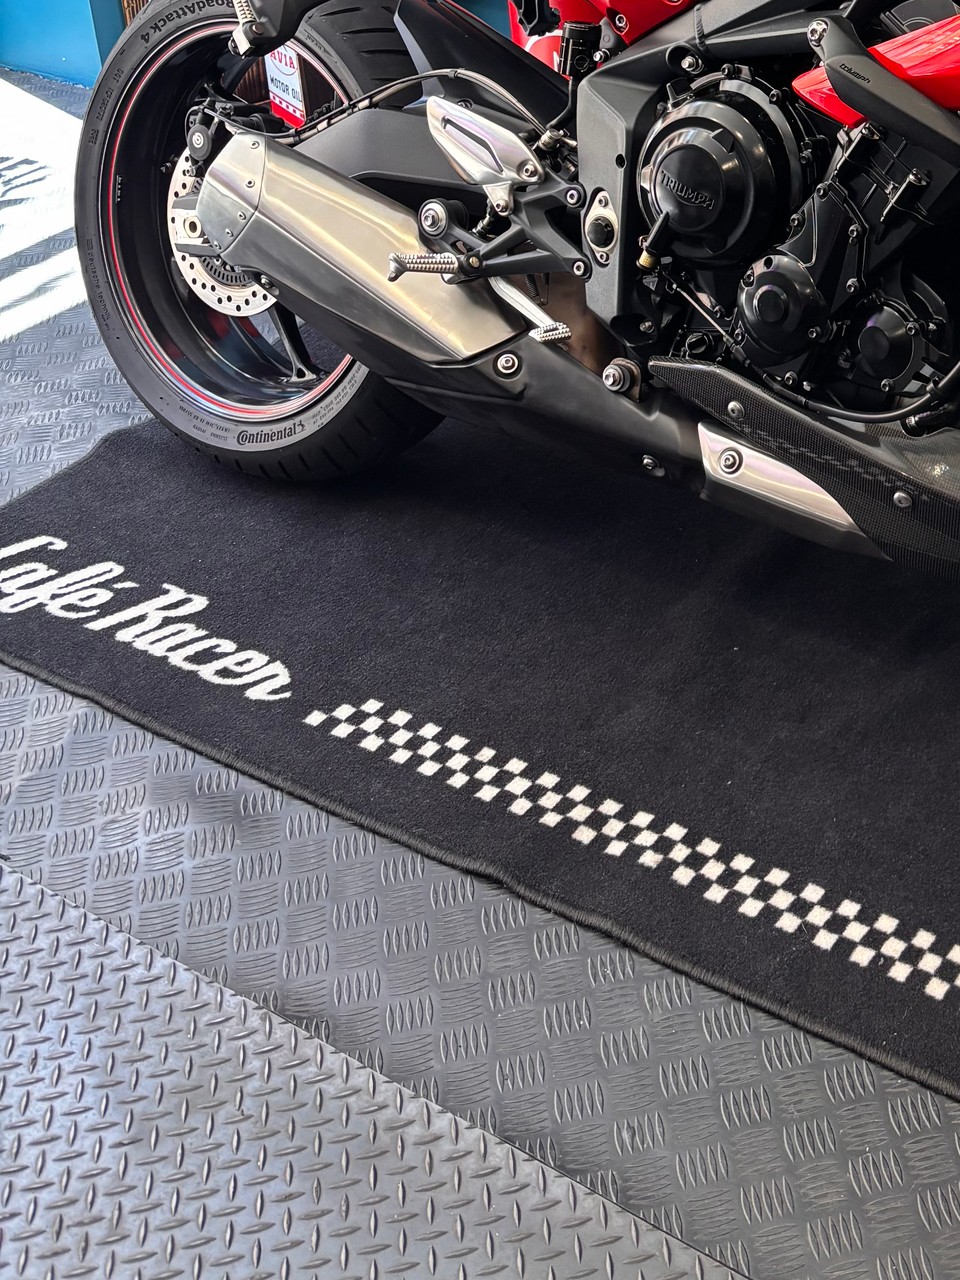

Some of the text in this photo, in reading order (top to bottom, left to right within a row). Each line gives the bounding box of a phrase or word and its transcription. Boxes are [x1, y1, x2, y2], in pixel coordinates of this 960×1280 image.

[141, 31, 150, 44] 4
[270, 50, 296, 70] AVIA
[270, 75, 302, 102] MOTOR OIL
[661, 170, 715, 210] TRIUMPH
[237, 422, 297, 446] Continental
[83, 582, 293, 701] Racer
